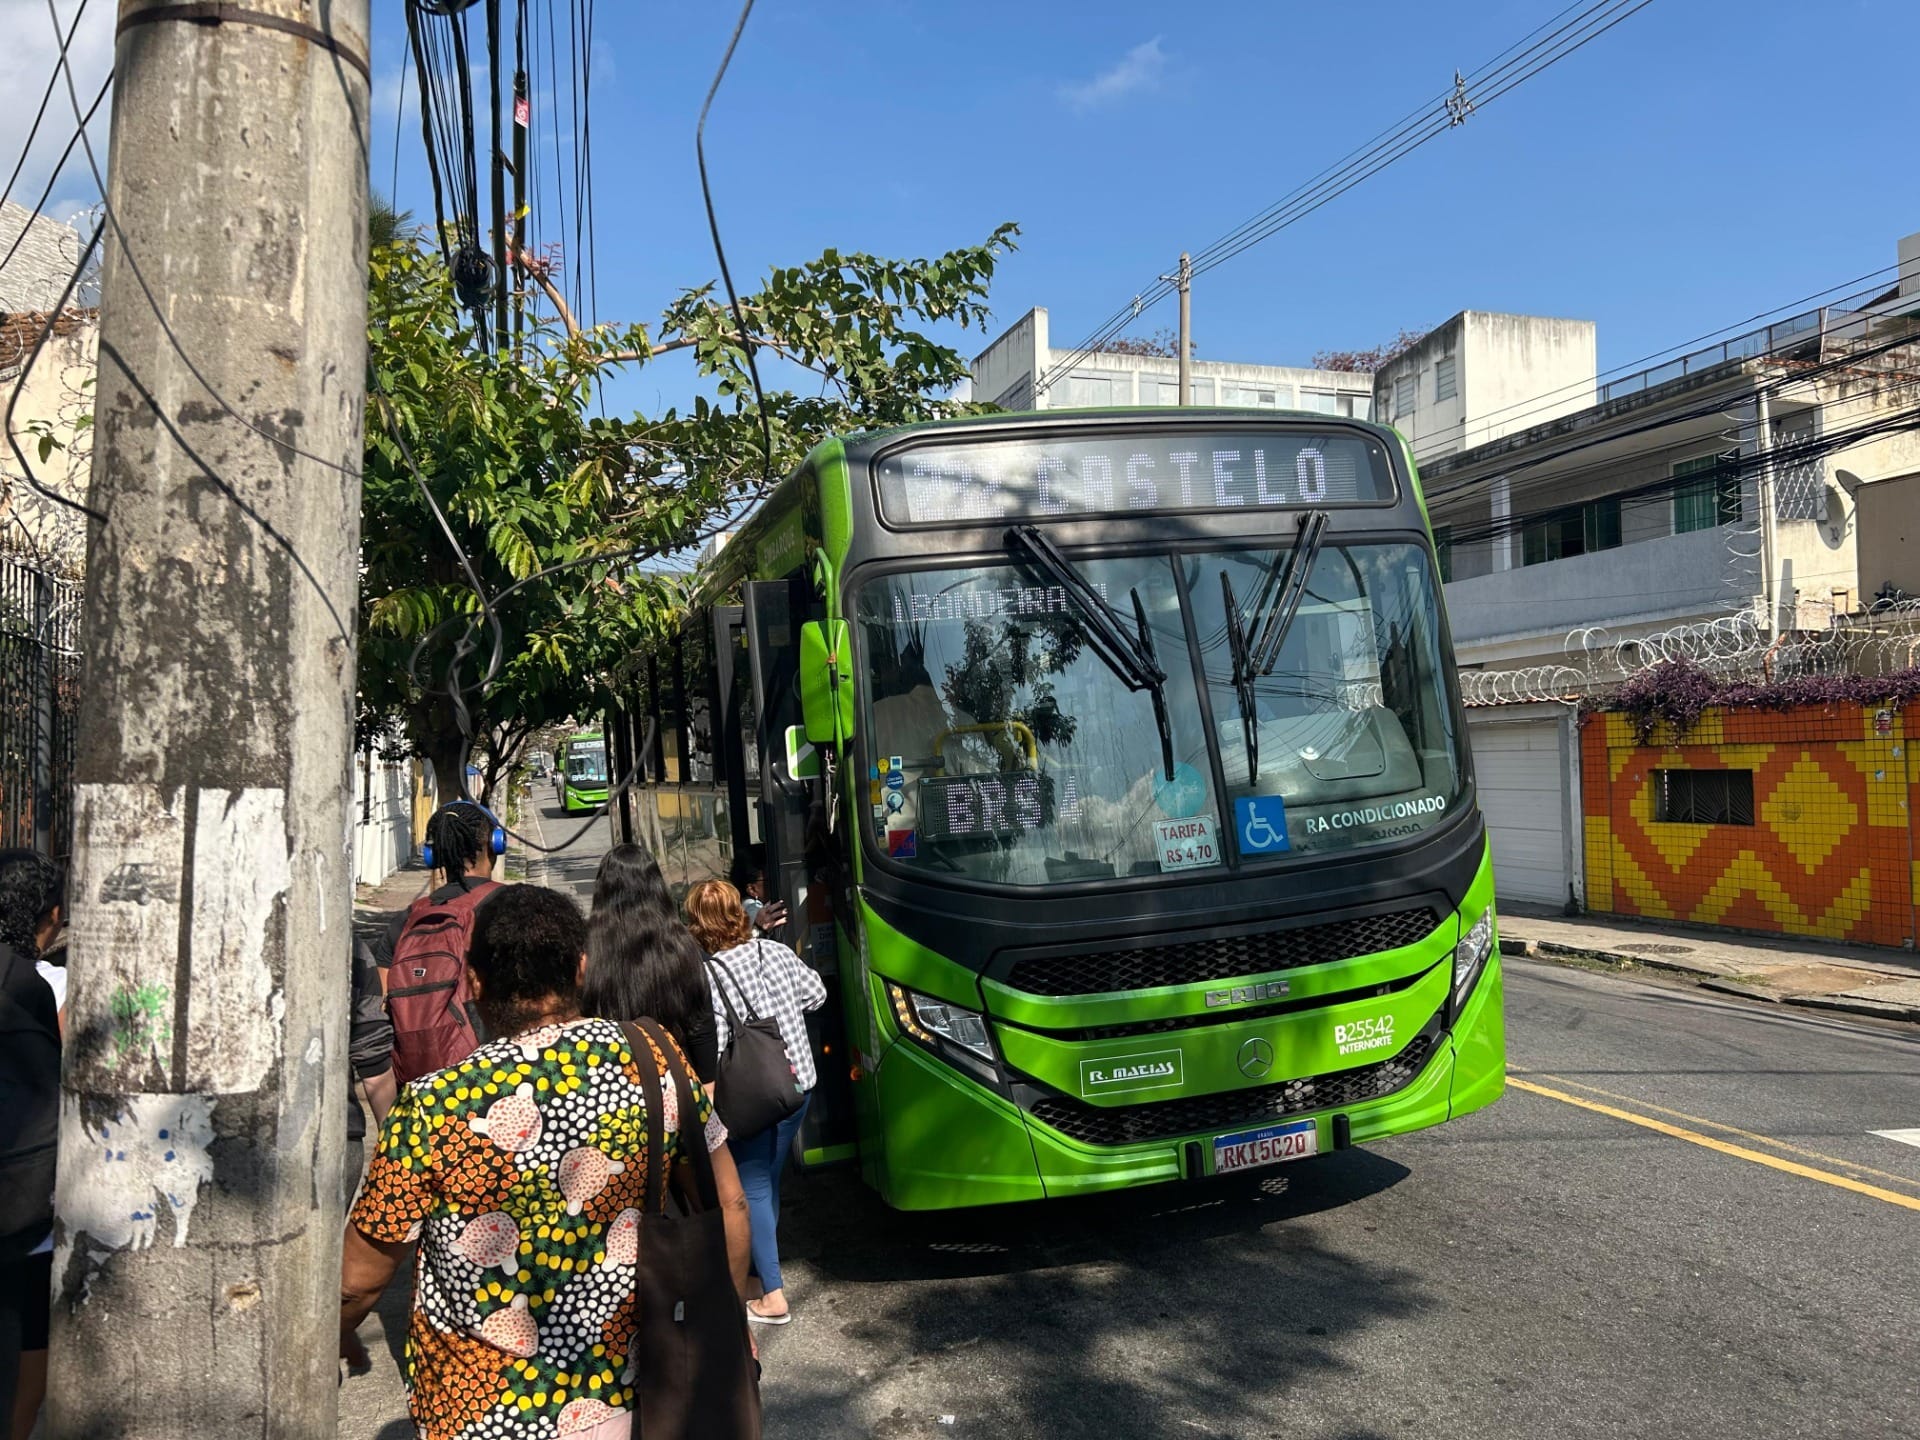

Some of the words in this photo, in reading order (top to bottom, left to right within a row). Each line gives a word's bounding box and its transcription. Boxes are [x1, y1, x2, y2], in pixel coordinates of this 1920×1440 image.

[913, 458, 1004, 520] 232
[1036, 448, 1327, 514] CASTELO
[911, 585, 1067, 621] BANDEIRA
[947, 778, 1042, 834] BRS
[1060, 775, 1083, 825] 4
[1331, 795, 1446, 829] CONDICIONADO
[1160, 822, 1207, 841] TARIFA
[1166, 848, 1183, 864] R$
[1186, 844, 1212, 861] 4,70
[1205, 980, 1290, 1008] CAIO
[1334, 1014, 1395, 1044] B25542
[1339, 1035, 1393, 1056] INTERNORTE
[1089, 1070, 1108, 1082] R.
[1223, 1133, 1306, 1169] RKI5C20
